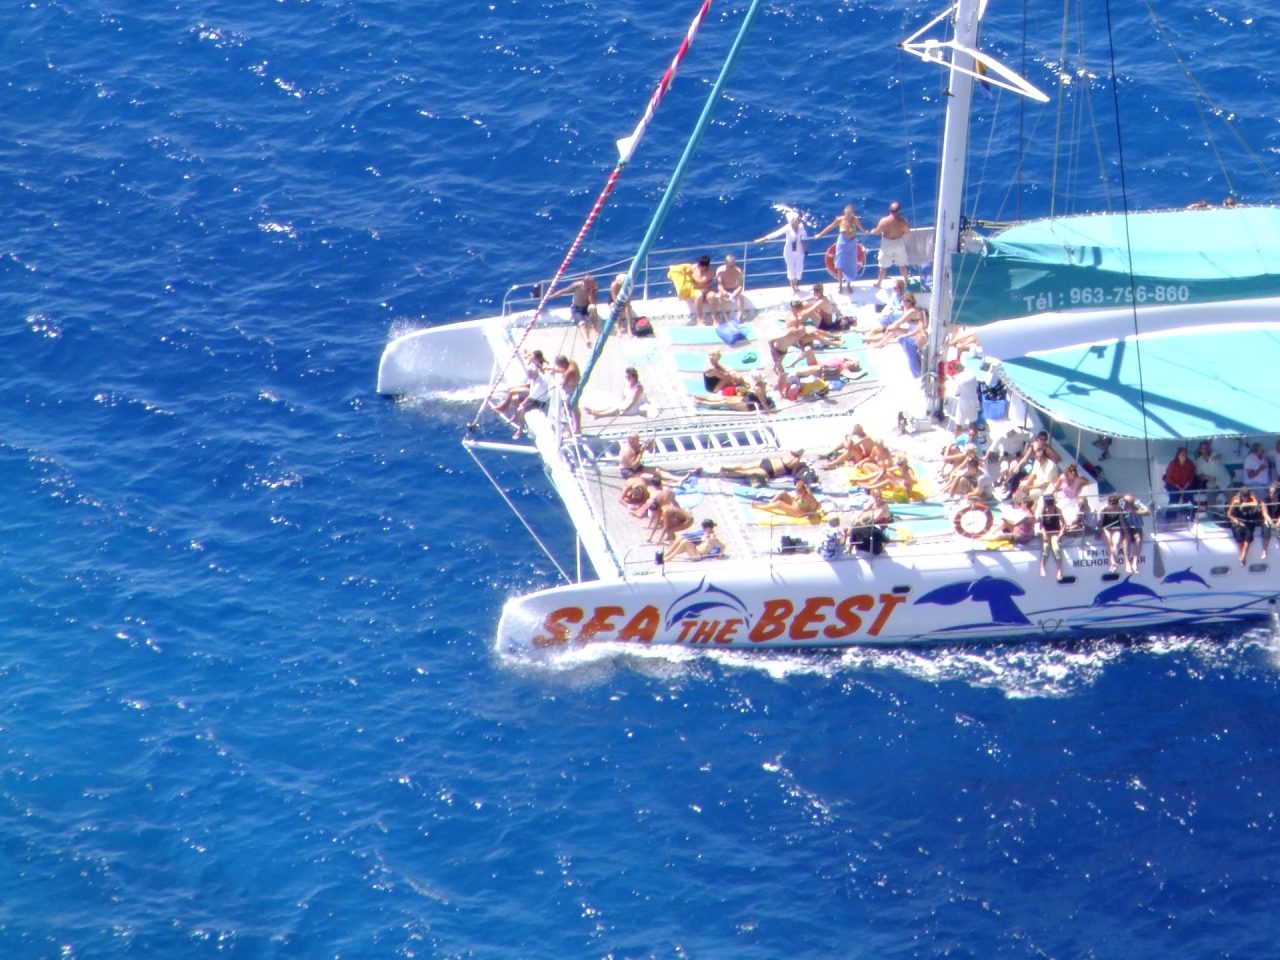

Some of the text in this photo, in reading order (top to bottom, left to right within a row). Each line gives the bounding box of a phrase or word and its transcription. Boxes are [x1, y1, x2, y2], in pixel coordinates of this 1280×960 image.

[1023, 292, 1053, 312] Tél
[1070, 285, 1189, 304] 963-796-860
[1073, 558, 1109, 567] MELHOR
[676, 617, 744, 644] THE
[748, 593, 907, 643] BEST
